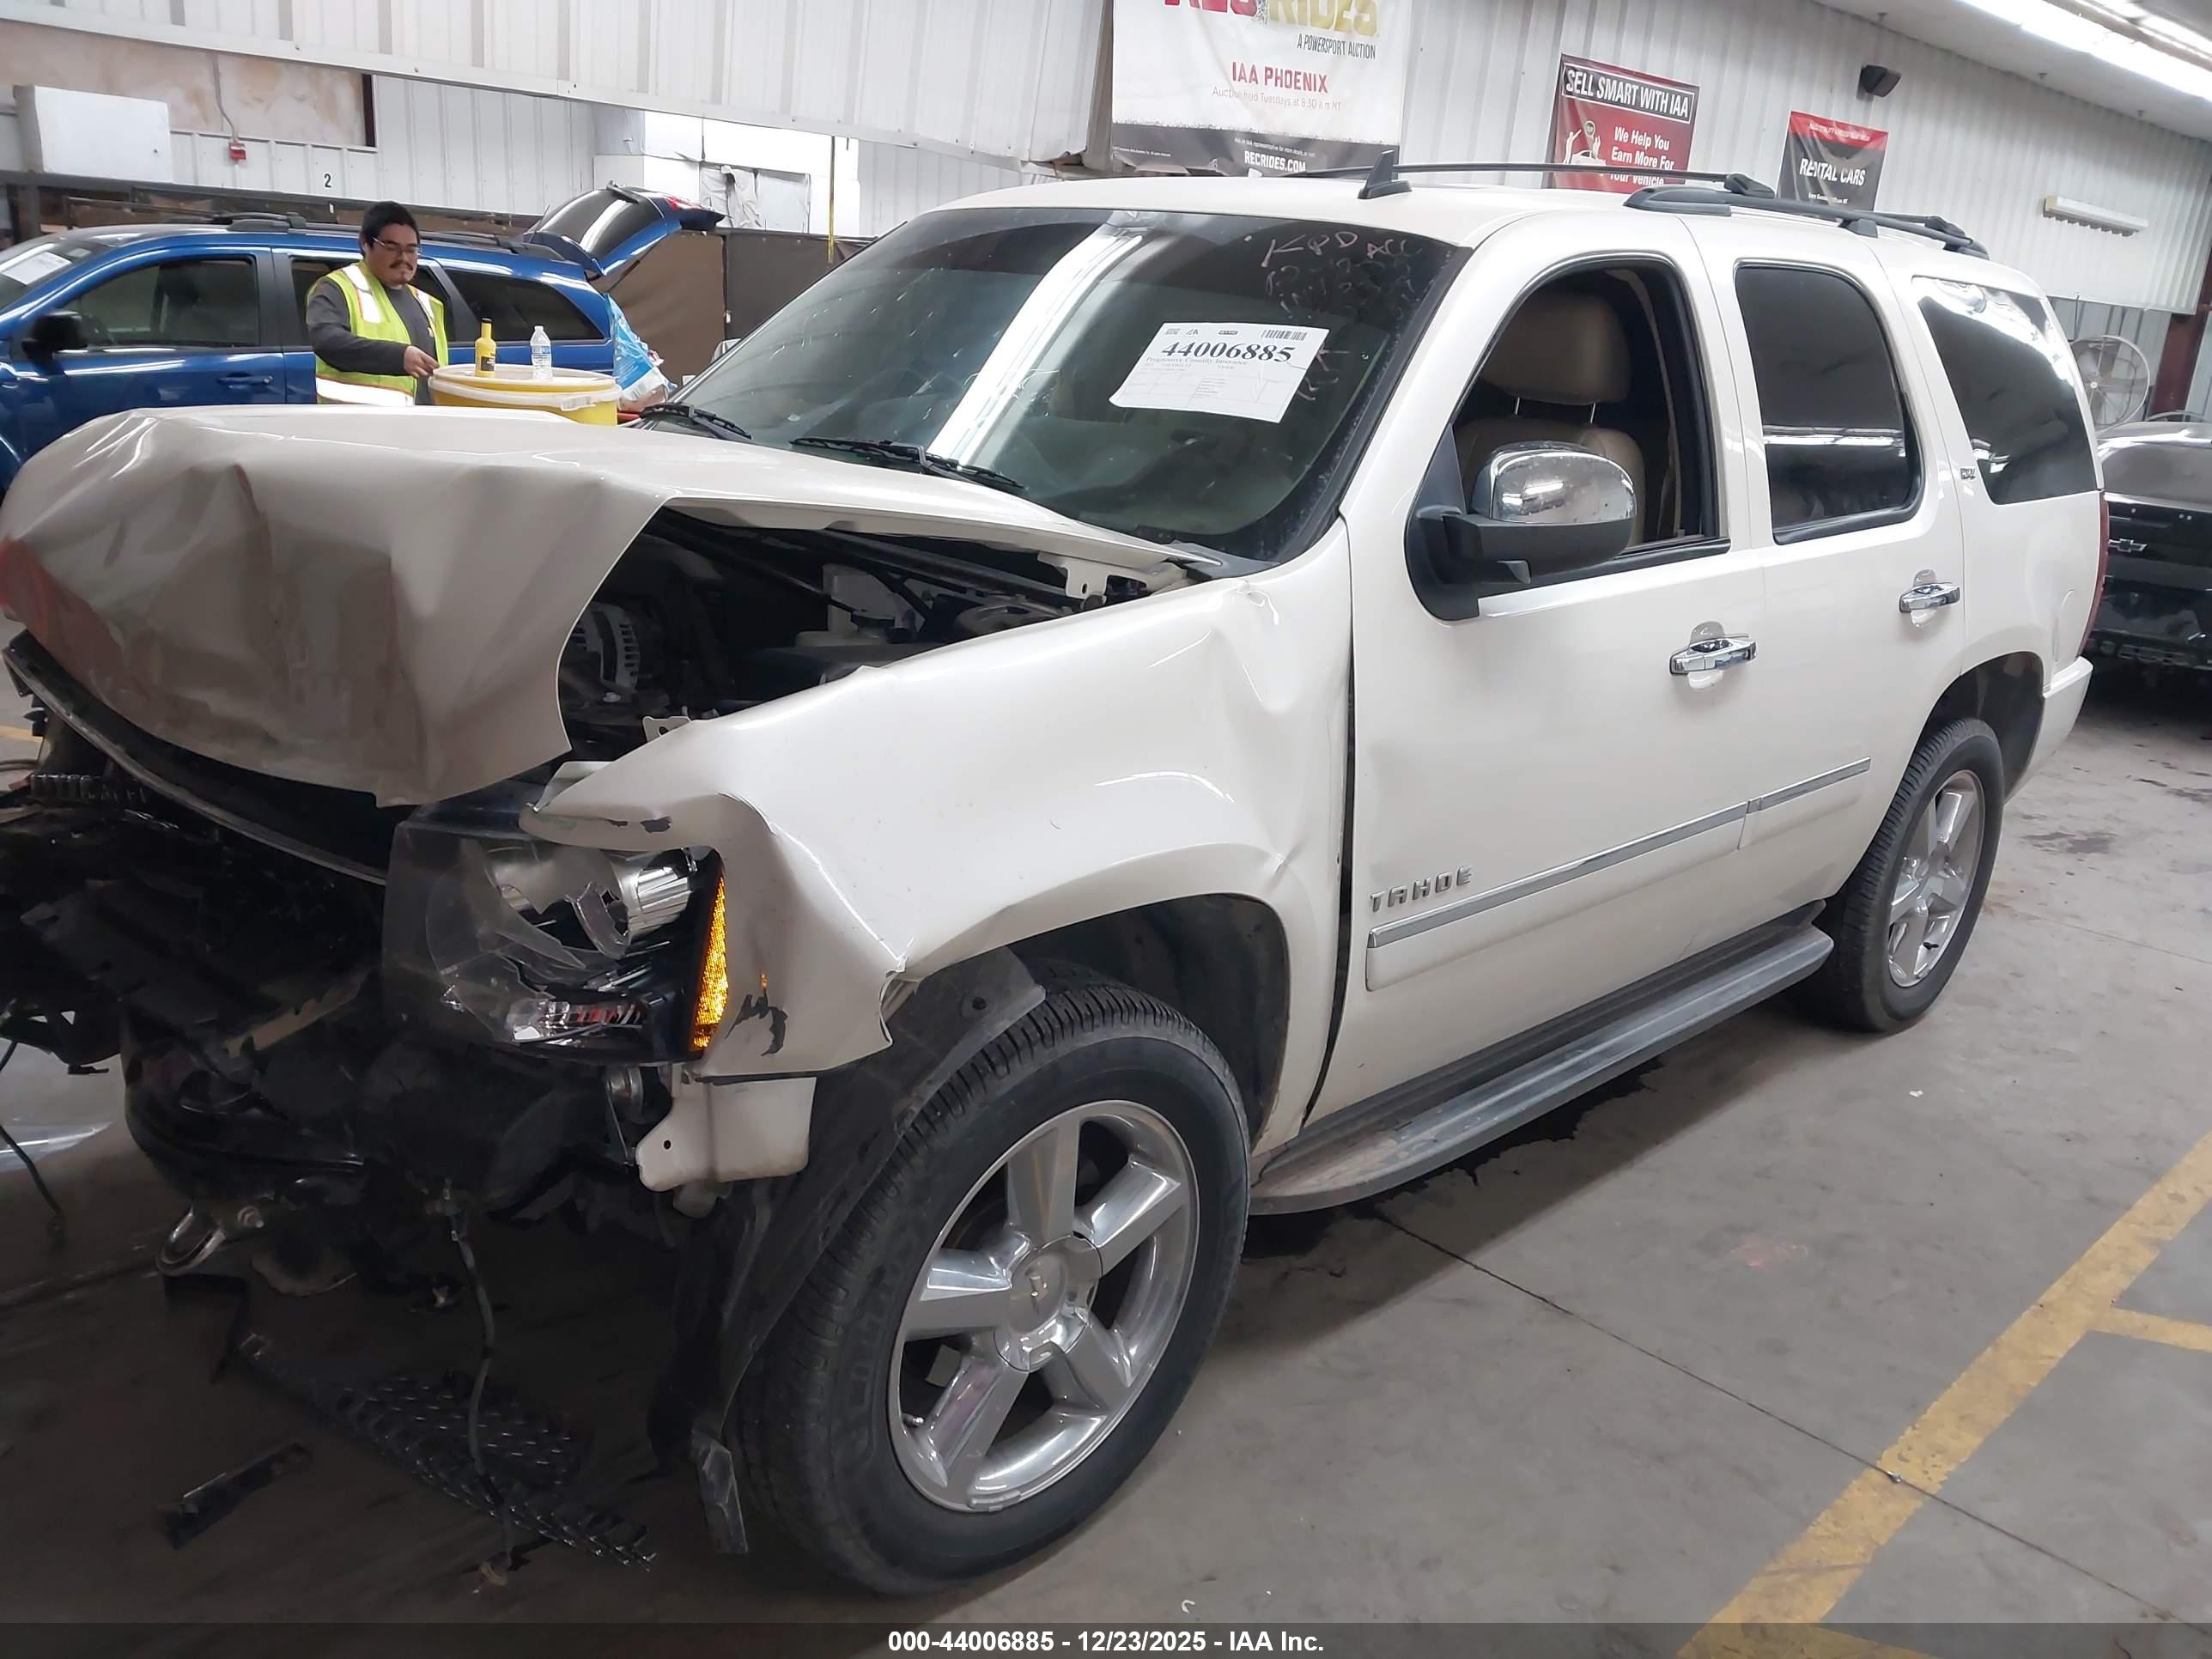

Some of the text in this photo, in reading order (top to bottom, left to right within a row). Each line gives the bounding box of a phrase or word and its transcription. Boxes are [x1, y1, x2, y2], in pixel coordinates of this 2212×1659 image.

[1297, 33, 1376, 59] A POWERSPORT AUCTION
[1232, 61, 1328, 94] IAA PHOENIX
[1566, 70, 1689, 118] SELL SMART WITH IAA
[1614, 126, 1670, 150] We Help You
[1244, 150, 1306, 173] RECRIDES.COM
[1611, 146, 1675, 170] Earn More For
[324, 173, 332, 188] 2
[1799, 158, 1866, 186] RENTAL CARS
[1161, 341, 1296, 362] 44006885
[1370, 866, 1472, 913] TAHOE
